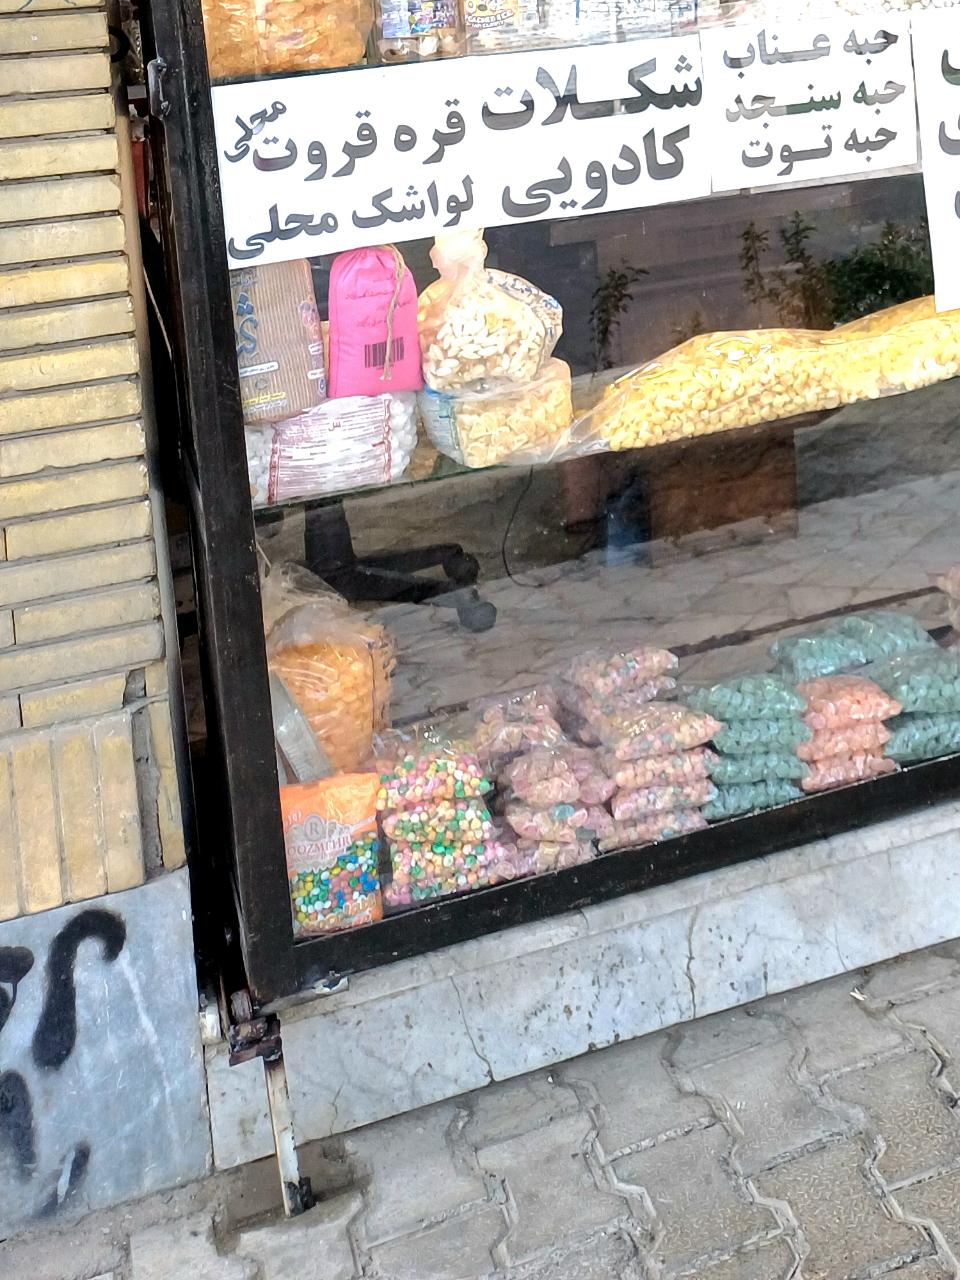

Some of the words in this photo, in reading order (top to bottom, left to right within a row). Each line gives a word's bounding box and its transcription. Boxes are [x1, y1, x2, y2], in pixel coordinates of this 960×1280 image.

[722, 28, 832, 80] عناب
[842, 29, 900, 66] حبه
[481, 55, 703, 131] شکلات
[724, 84, 843, 130] سنجد
[852, 80, 907, 116] حبه
[252, 109, 379, 182] قروت
[393, 99, 467, 165] قره
[740, 124, 833, 177] توت
[843, 123, 898, 163] حبه
[501, 125, 692, 219] کادویی
[351, 175, 475, 228] لواشک
[227, 203, 340, 262] محلی
[287, 836, 352, 858] OOZMEHR
